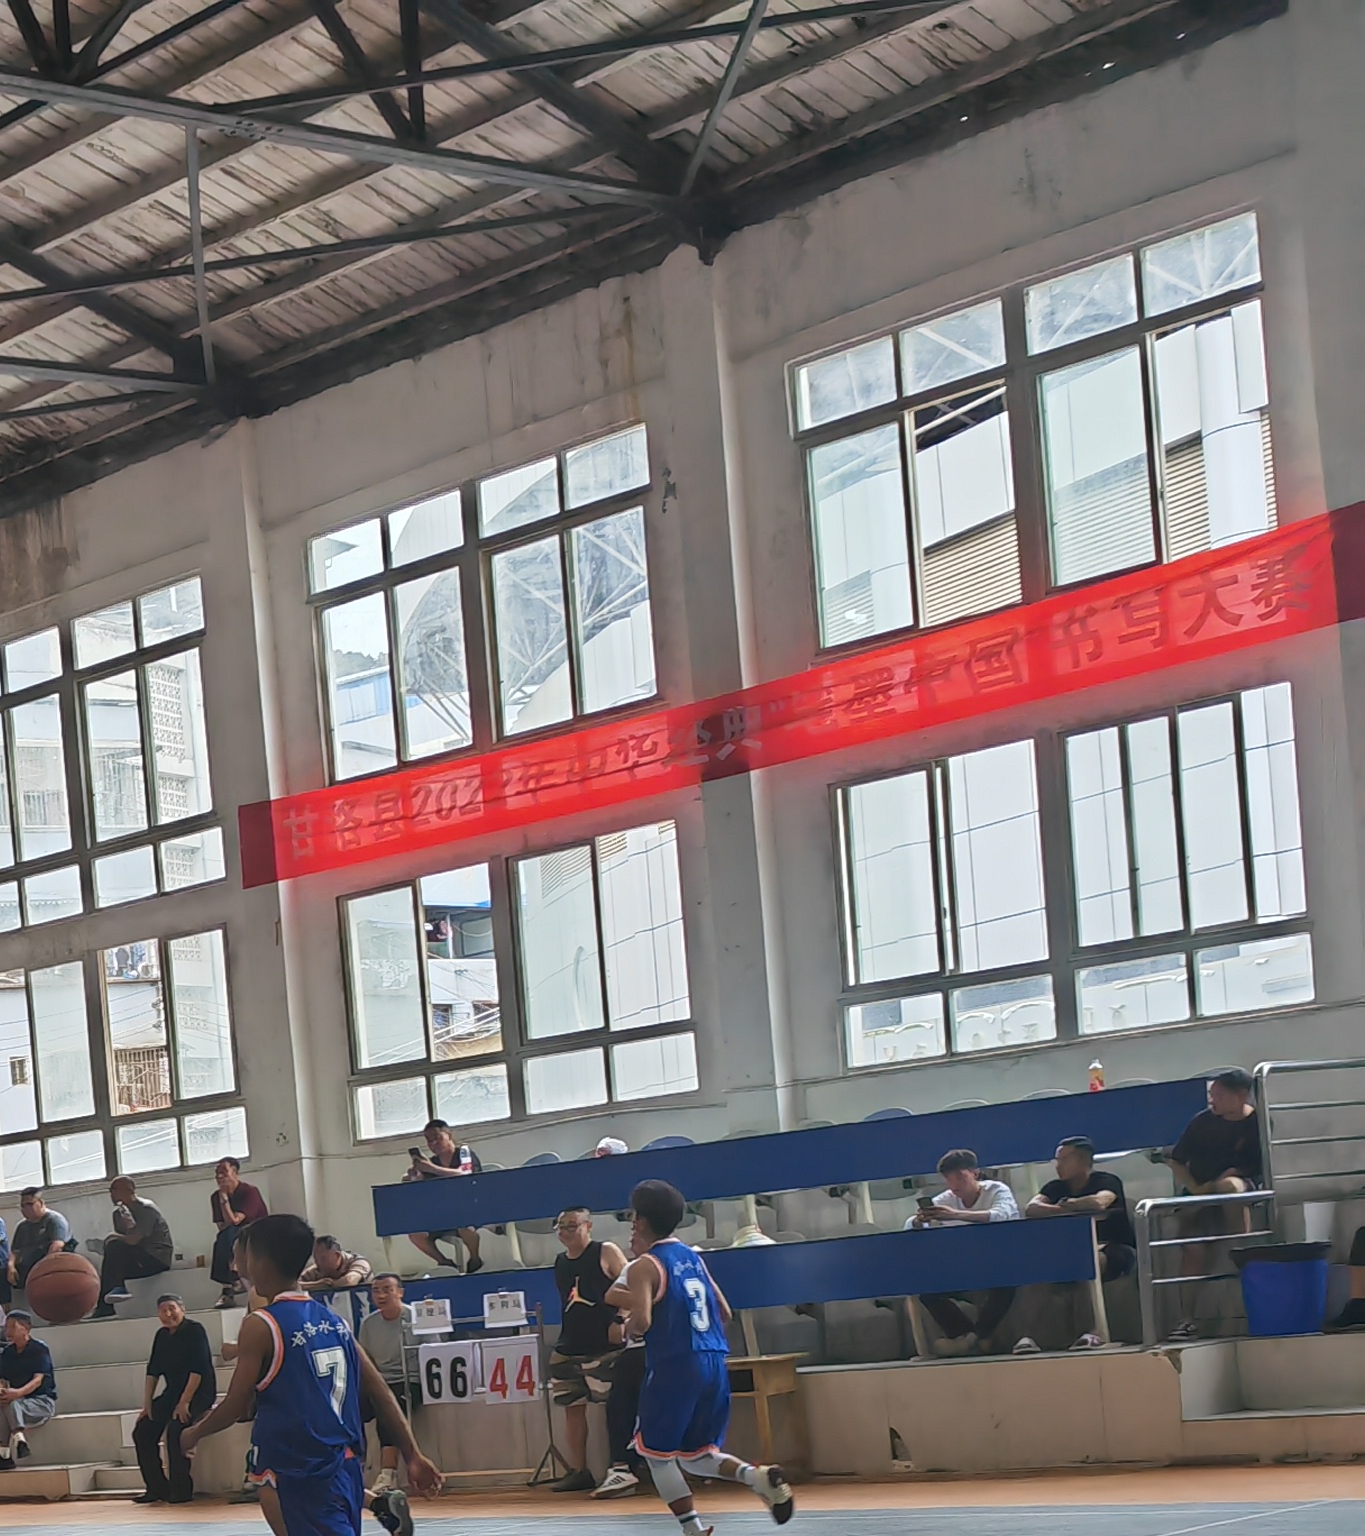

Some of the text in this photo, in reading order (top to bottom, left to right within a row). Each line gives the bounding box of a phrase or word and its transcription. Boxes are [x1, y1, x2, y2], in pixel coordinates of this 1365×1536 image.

[683, 1278, 710, 1332] 3
[311, 1346, 347, 1425] 7
[425, 1355, 536, 1399] 66 44
